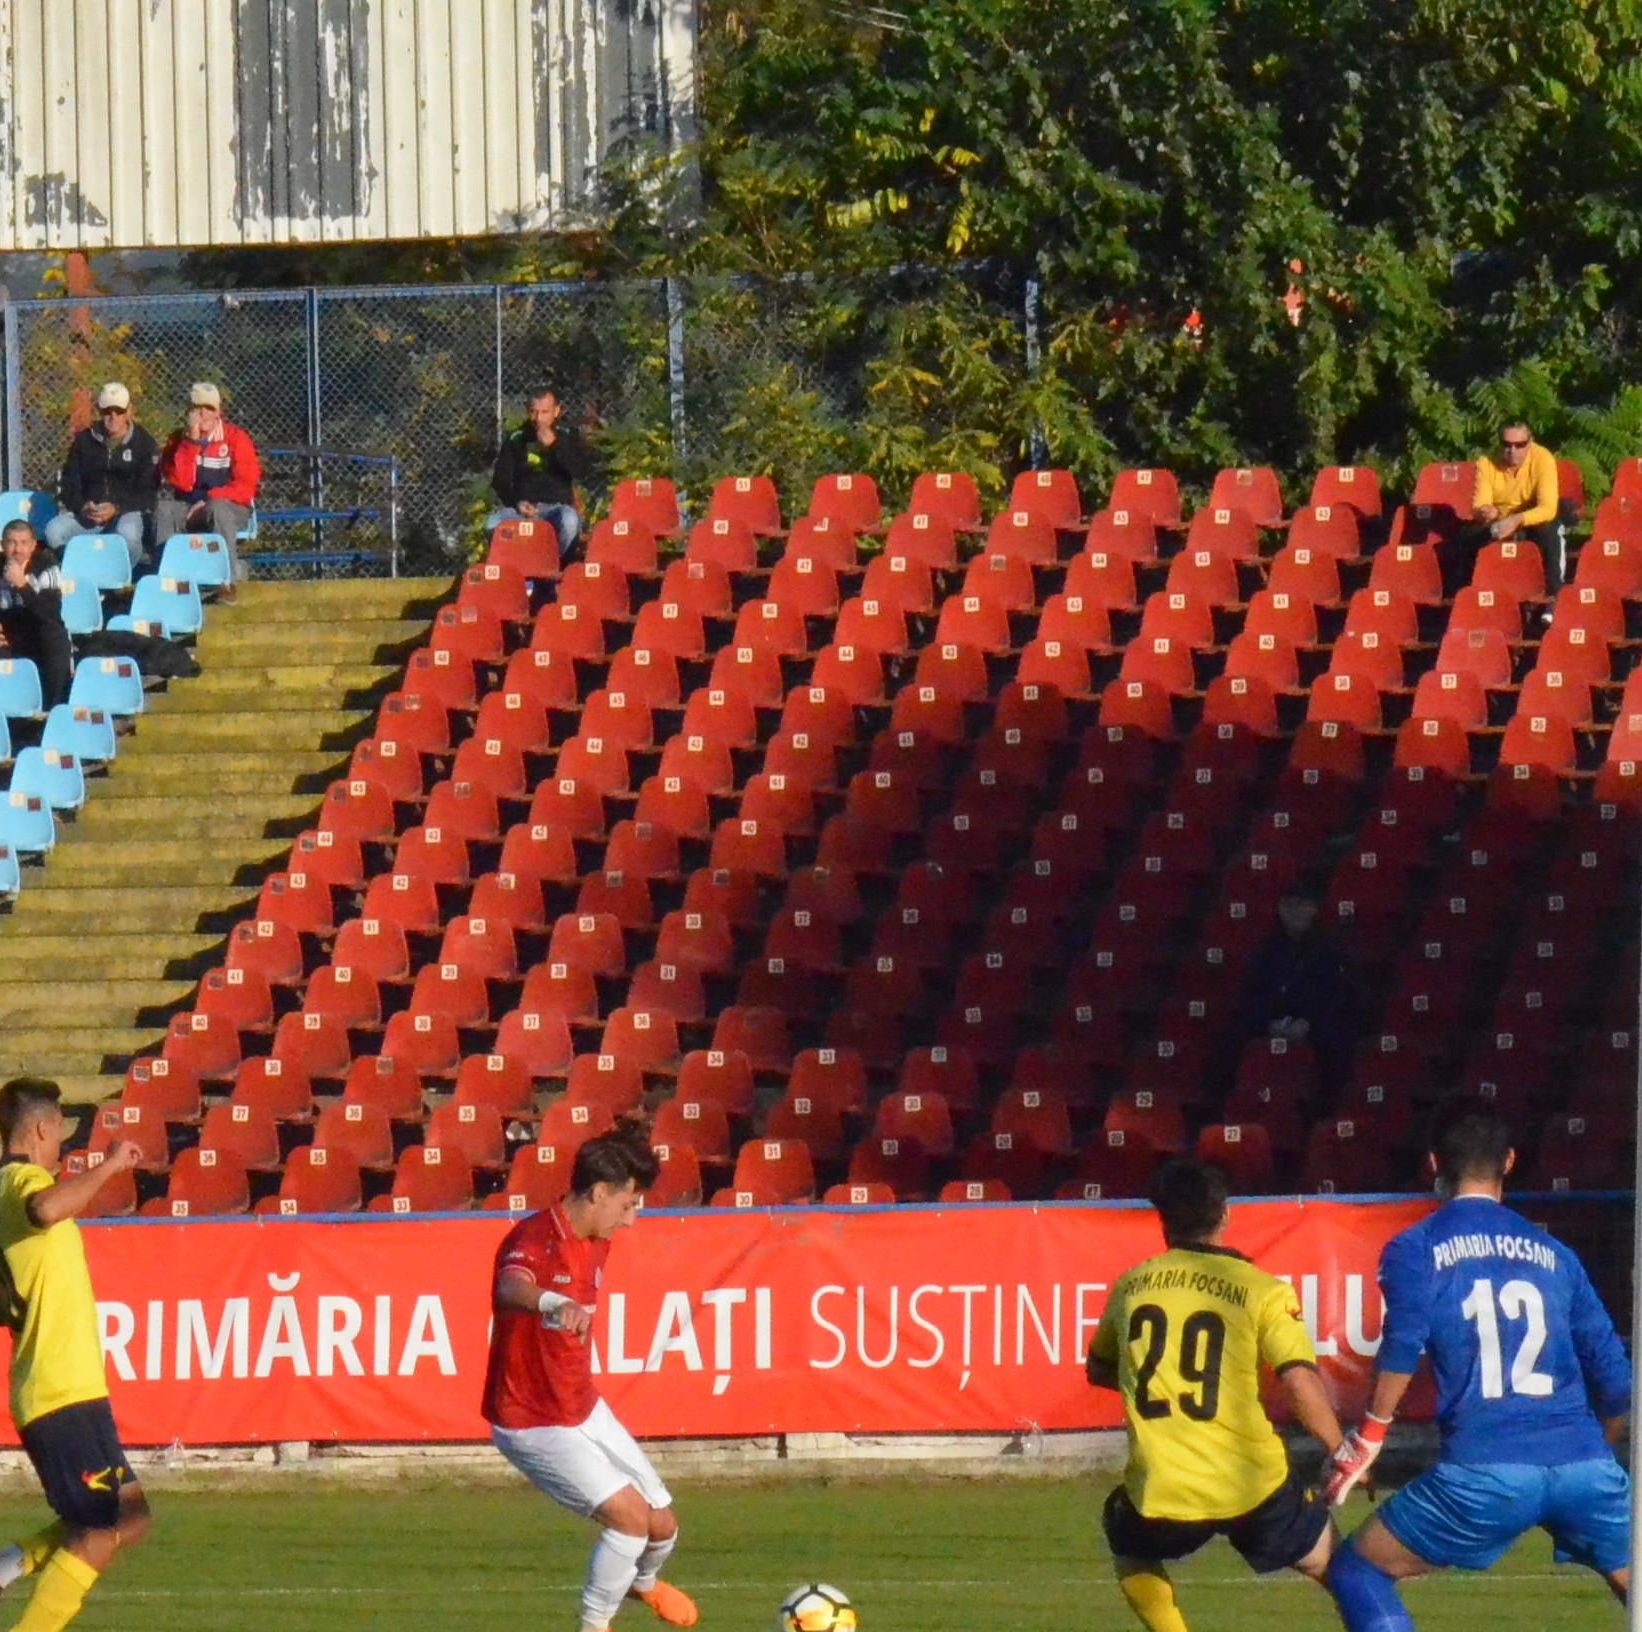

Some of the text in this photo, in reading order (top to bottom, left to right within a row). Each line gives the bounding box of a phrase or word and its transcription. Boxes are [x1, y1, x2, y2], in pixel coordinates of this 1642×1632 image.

[852, 1189, 865, 1202] 29
[969, 1185, 982, 1198] 28
[1433, 1233, 1556, 1273] PRIMARIA FOCSANI
[1188, 1271, 1249, 1308] FOCSANI
[96, 1271, 458, 1382] RIMĂRIA
[1462, 1278, 1554, 1399] 12
[1129, 1303, 1226, 1421] 29
